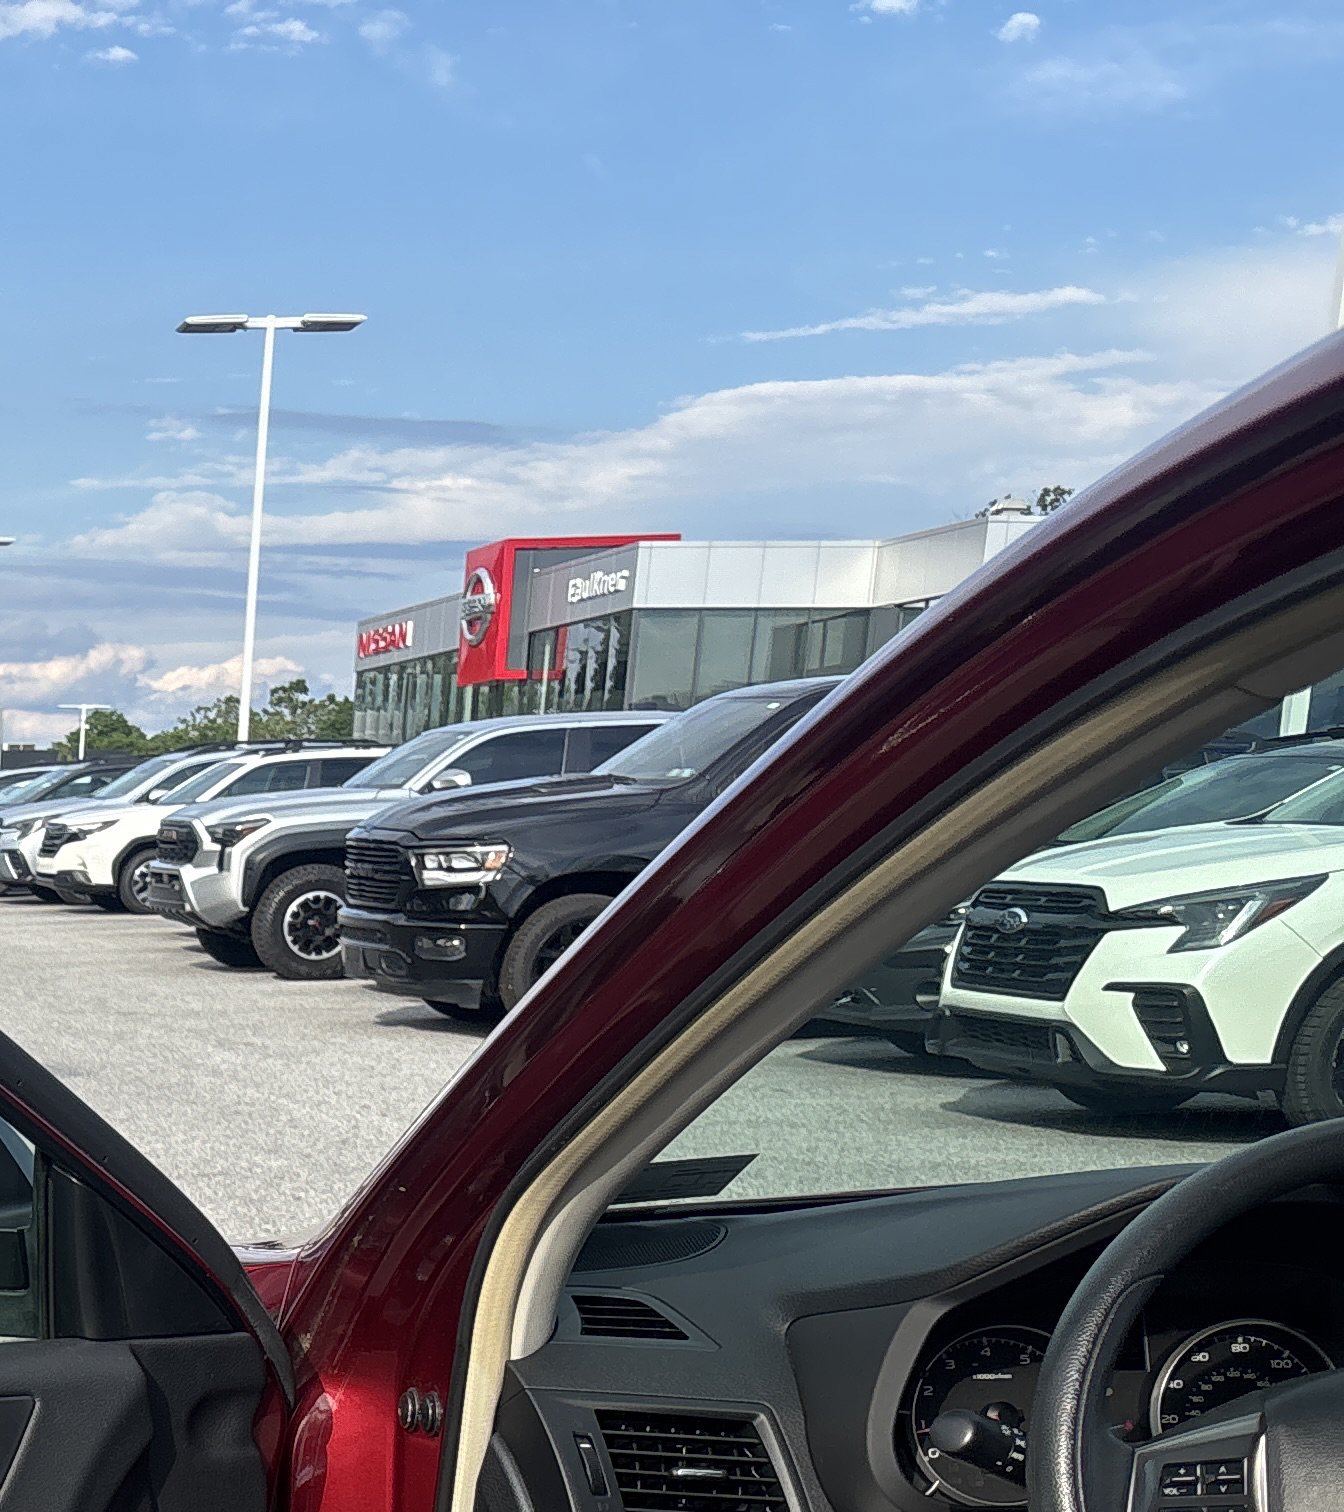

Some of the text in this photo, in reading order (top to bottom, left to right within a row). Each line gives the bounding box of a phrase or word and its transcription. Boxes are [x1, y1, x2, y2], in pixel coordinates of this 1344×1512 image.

[568, 569, 629, 602] Faulkner
[358, 621, 413, 658] NISSAN
[980, 1346, 991, 1357] 4
[945, 1359, 956, 1370] 3
[1019, 1354, 1031, 1365] 5
[1270, 1359, 1293, 1369] 100
[924, 1385, 934, 1395] 2
[1161, 1414, 1179, 1423] 20
[928, 1447, 940, 1458] 0
